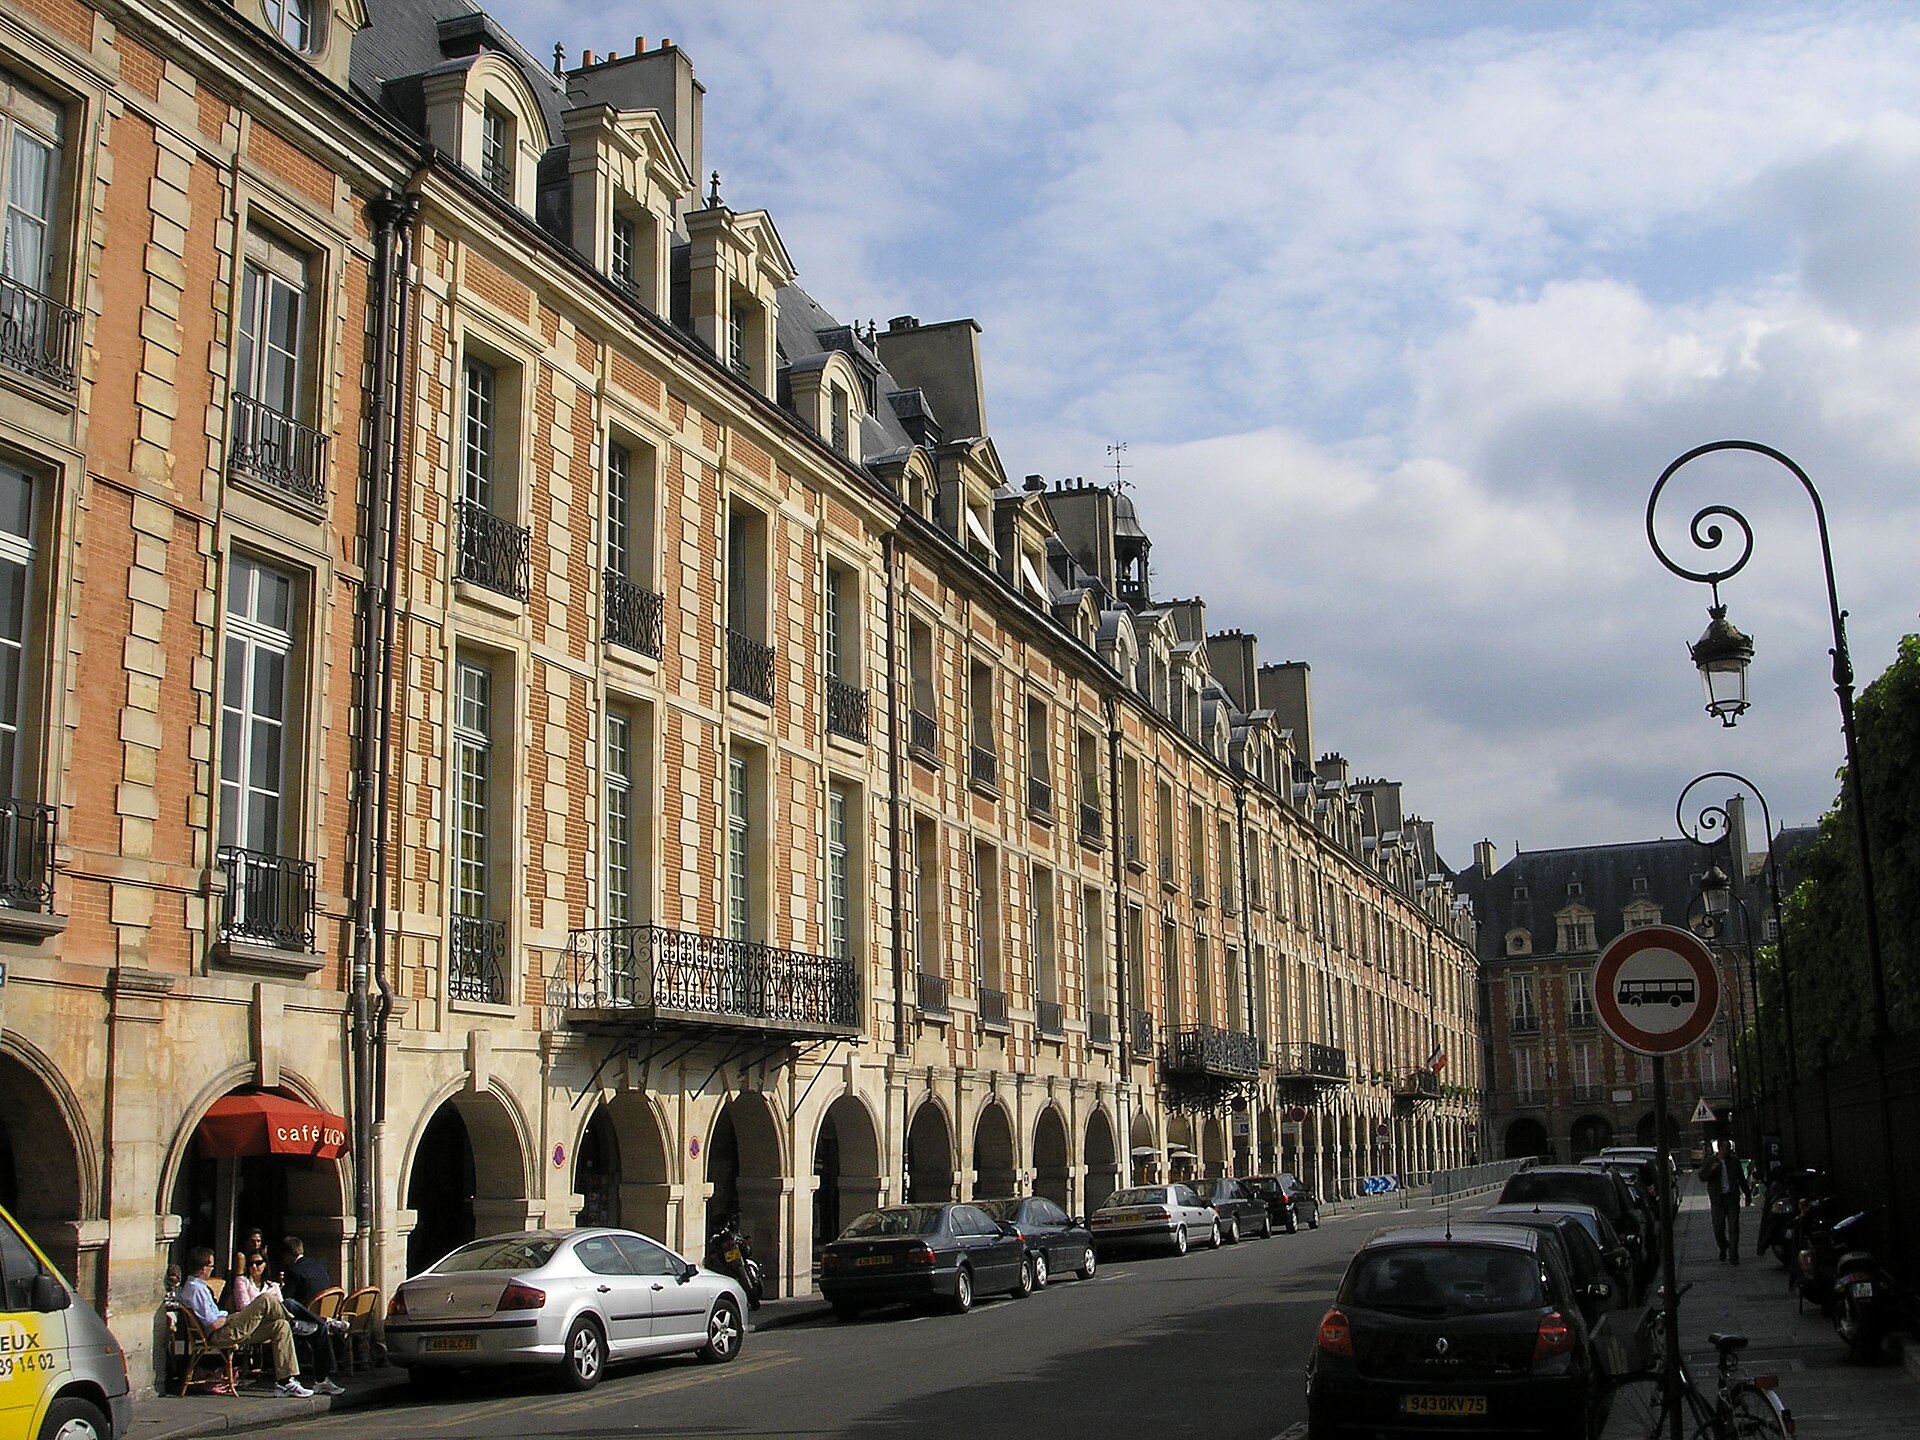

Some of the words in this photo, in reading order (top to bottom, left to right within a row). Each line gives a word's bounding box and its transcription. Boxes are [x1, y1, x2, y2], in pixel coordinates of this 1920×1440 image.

[277, 1124, 320, 1143] café
[19, 1355, 35, 1372] 14
[38, 1353, 55, 1370] 02
